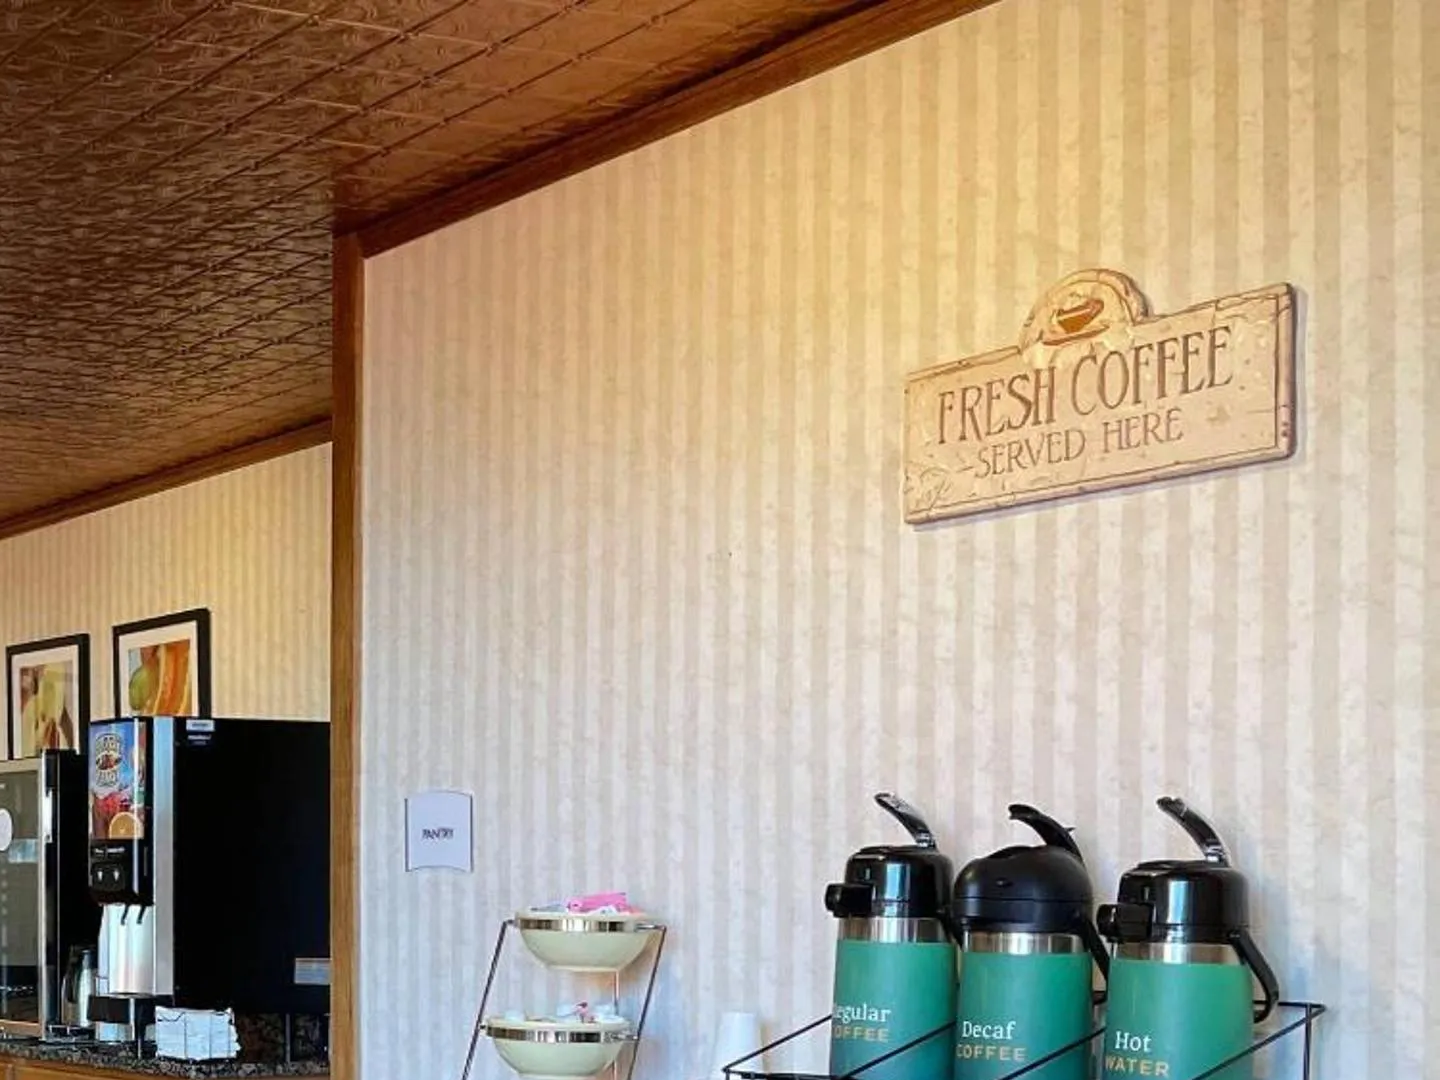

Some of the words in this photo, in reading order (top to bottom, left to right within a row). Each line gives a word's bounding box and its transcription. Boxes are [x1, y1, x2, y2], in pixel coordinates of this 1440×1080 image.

[938, 364, 1057, 445] FRESH
[1071, 325, 1233, 416] COFFEE
[974, 429, 1087, 479] SERVED
[1102, 407, 1184, 454] HERE
[833, 1025, 890, 1043] OFFEE
[962, 1020, 1017, 1040] Decaf
[1114, 1030, 1153, 1053] Hot
[956, 1044, 1027, 1062] COFFEE
[1105, 1055, 1170, 1077] WATER
